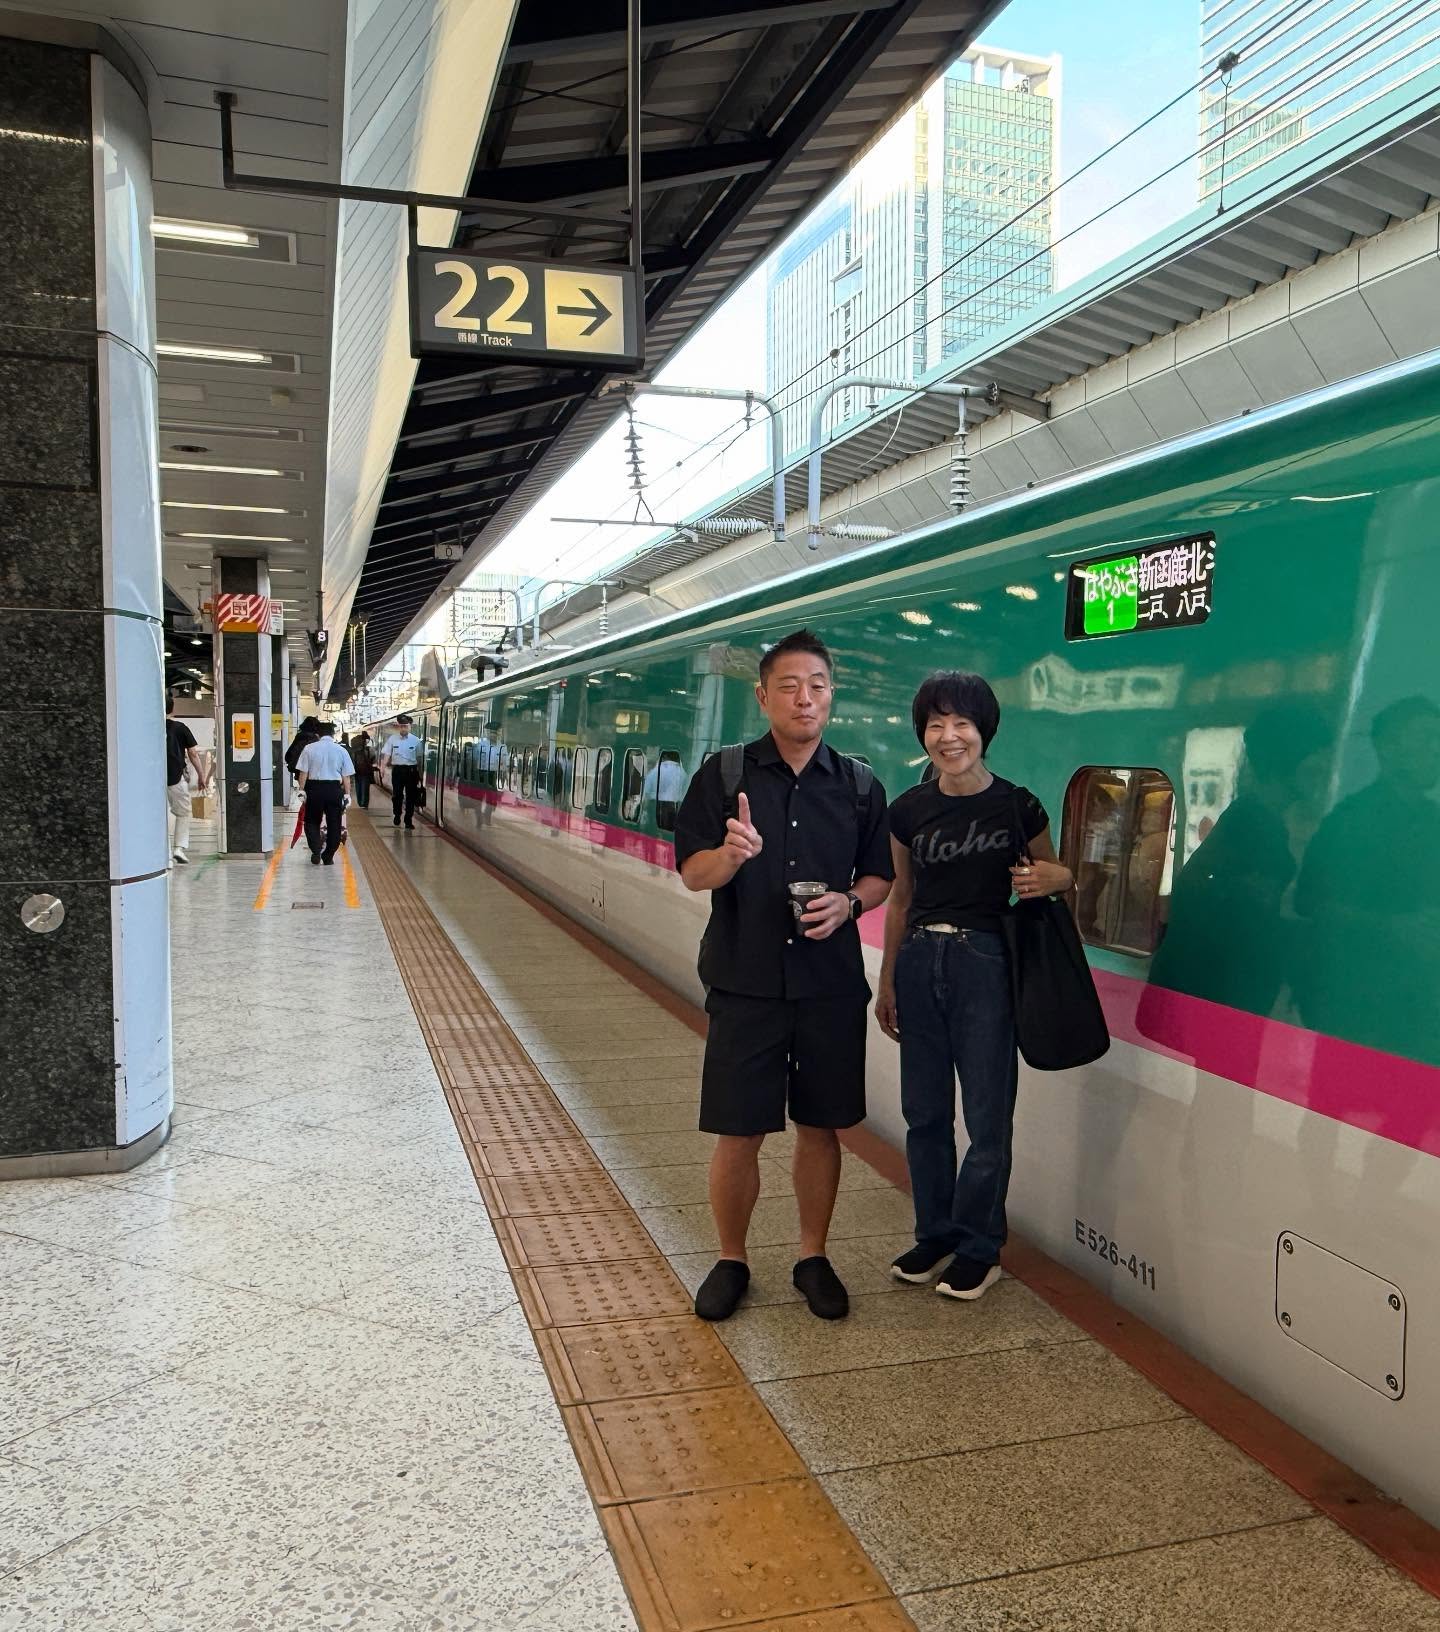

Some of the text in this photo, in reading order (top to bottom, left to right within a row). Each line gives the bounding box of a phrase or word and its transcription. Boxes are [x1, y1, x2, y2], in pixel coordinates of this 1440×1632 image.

[434, 260, 533, 335] 22
[481, 333, 513, 347] Track
[1084, 562, 1138, 603] はやぶさ
[1106, 599, 1114, 626] 1
[317, 631, 326, 642] 8
[1075, 1218, 1156, 1291] E526-411
